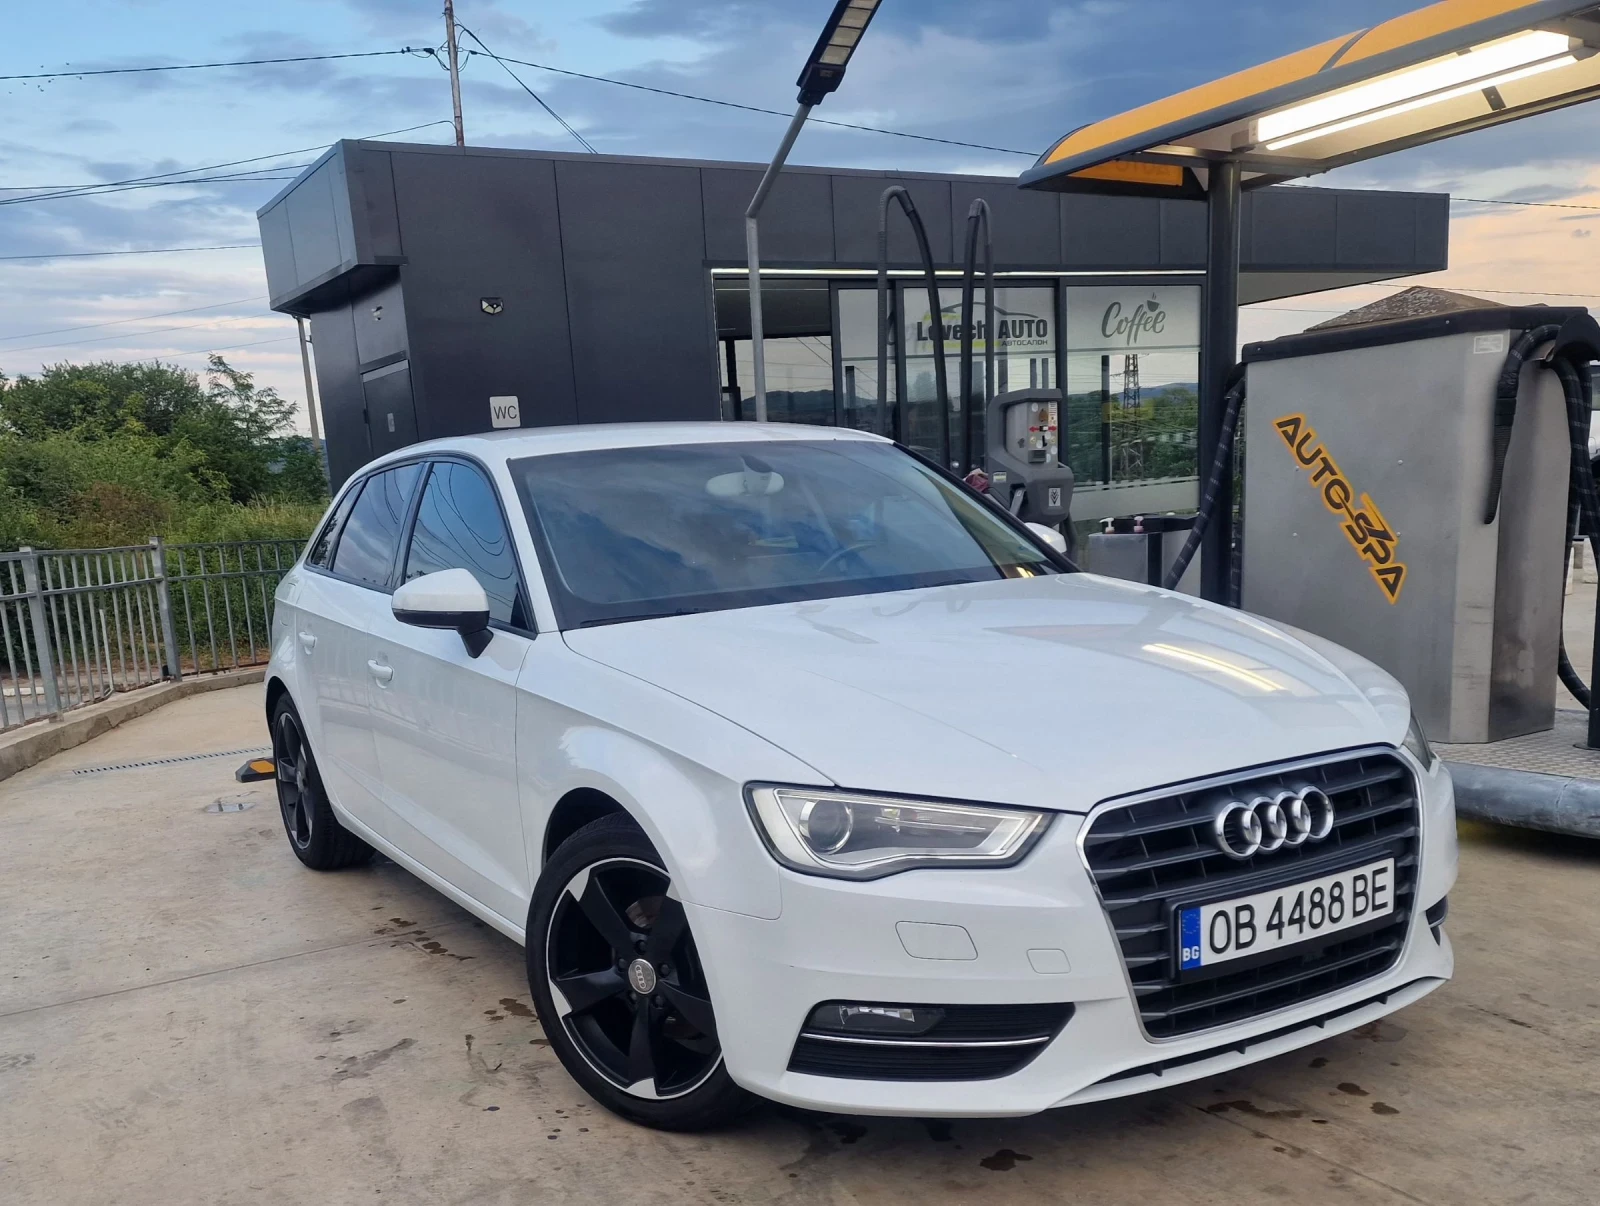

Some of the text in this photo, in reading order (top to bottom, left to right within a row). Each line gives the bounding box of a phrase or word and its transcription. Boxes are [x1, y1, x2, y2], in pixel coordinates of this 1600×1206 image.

[998, 319, 1048, 339] AUTO
[1101, 301, 1166, 345] Coffee
[1002, 339, 1048, 347] АВТОСАЛОН
[493, 405, 517, 420] WC
[1209, 866, 1389, 955] OB 4488 BE
[1182, 946, 1200, 961] BG
